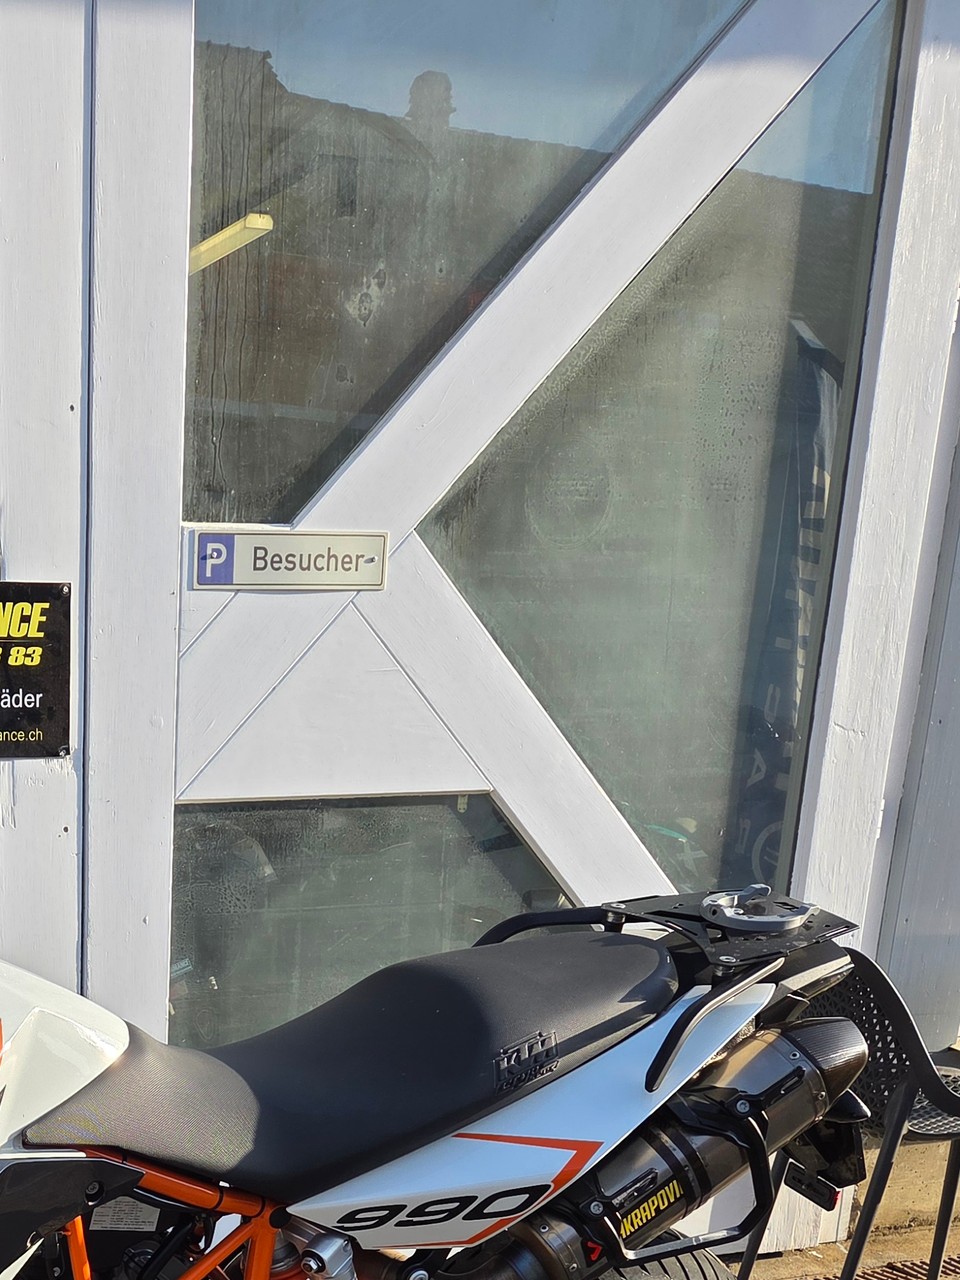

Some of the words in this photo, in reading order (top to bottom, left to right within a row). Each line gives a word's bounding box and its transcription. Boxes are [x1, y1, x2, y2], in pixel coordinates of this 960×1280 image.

[252, 546, 365, 571] Besucher
[8, 646, 43, 666] 83
[336, 1183, 553, 1230] 990
